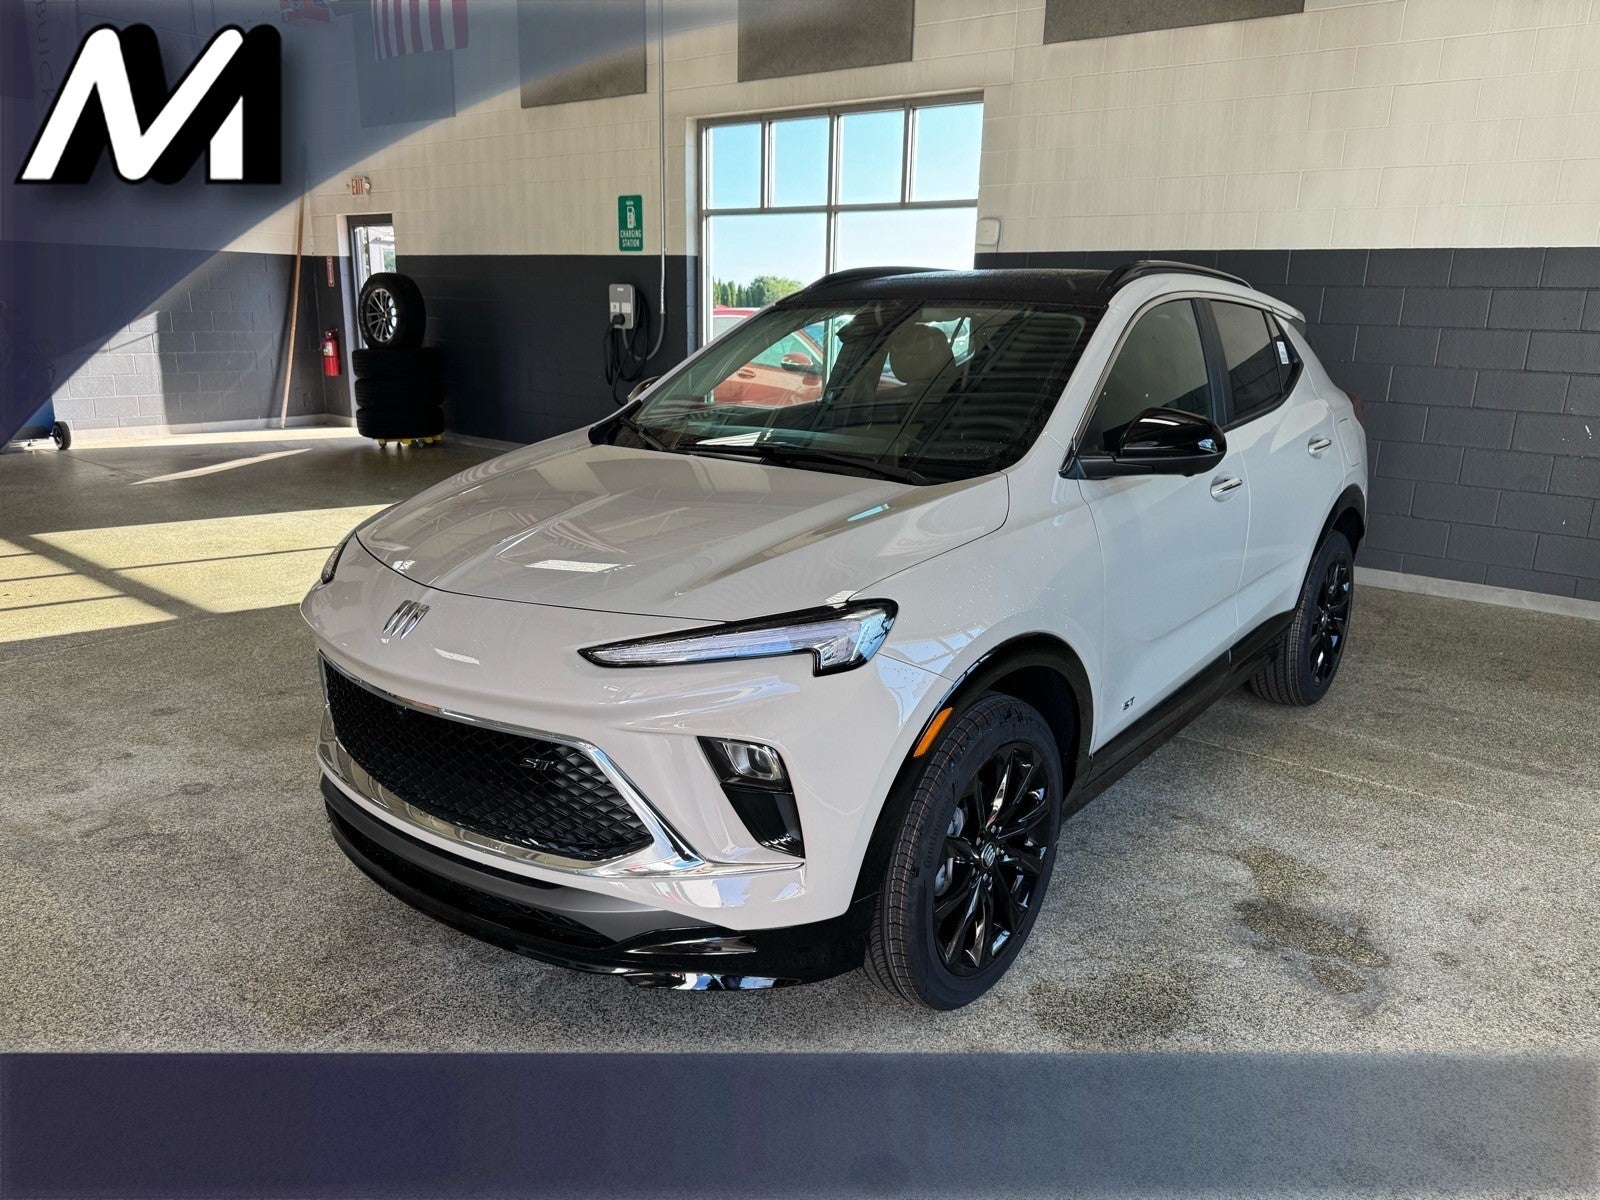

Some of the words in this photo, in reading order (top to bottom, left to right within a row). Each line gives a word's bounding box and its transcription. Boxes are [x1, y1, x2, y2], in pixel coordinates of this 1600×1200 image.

[36, 0, 55, 107] BUICK
[351, 178, 364, 195] EXIT
[620, 229, 642, 239] CHARGING
[622, 239, 640, 248] STATION
